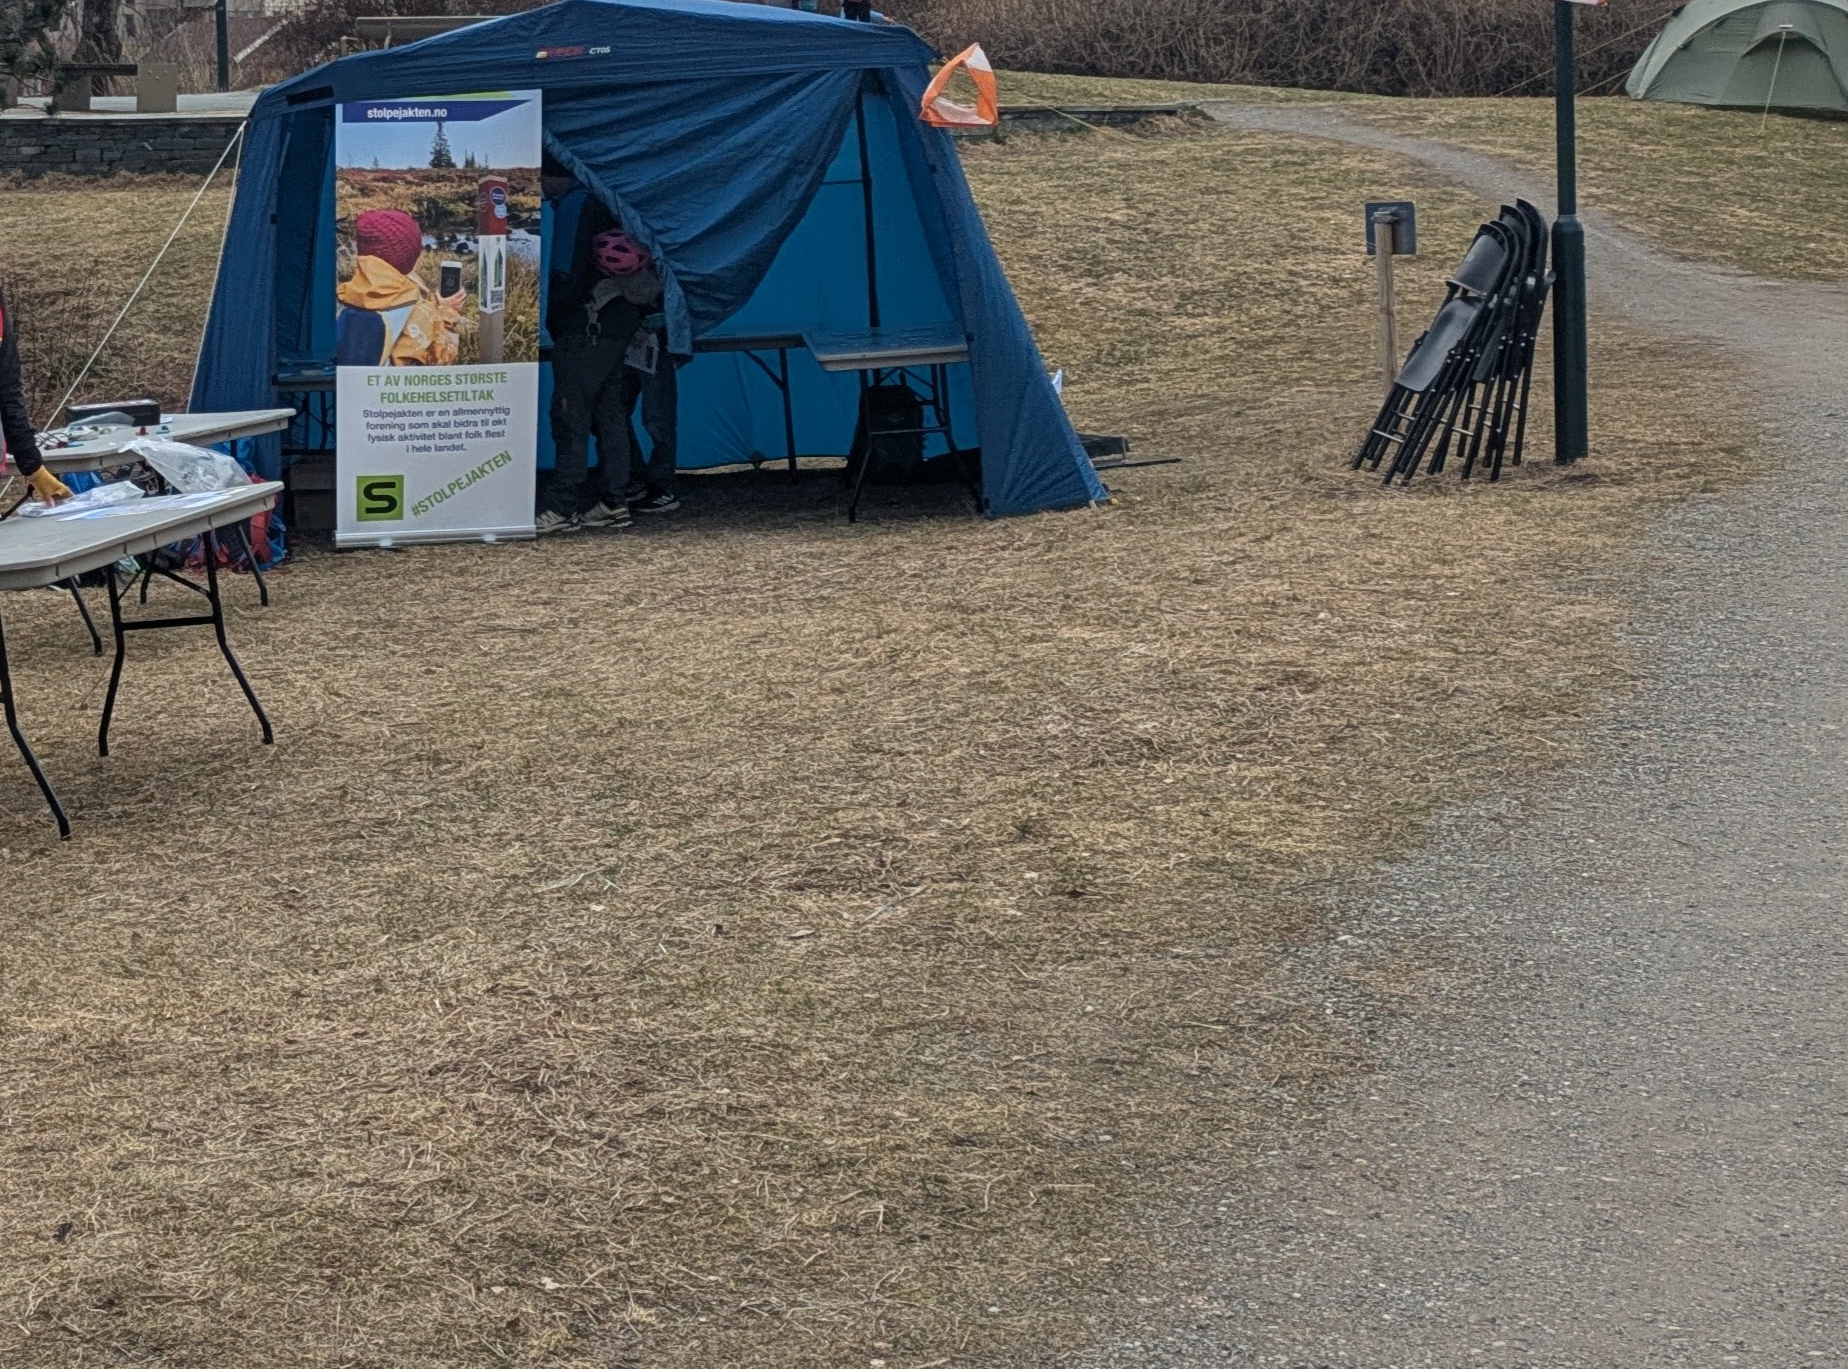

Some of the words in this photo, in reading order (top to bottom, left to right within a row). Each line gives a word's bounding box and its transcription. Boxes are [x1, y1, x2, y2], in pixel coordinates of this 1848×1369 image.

[367, 107, 448, 120] stolpejakten.no
[367, 375, 382, 386] ET
[384, 374, 400, 386] AV
[404, 374, 452, 386] NORGES
[455, 372, 508, 385] STØRSTE
[380, 389, 494, 404] FOLKEHELSETILTAK
[362, 409, 423, 420] Stolpejakten
[426, 410, 436, 418] er
[438, 409, 450, 417] en
[366, 421, 406, 432] forening
[408, 422, 429, 430] som
[432, 420, 451, 429] skal
[454, 419, 478, 428] bidra
[480, 418, 490, 427] til
[367, 433, 395, 444] fysisk
[398, 432, 436, 442] aktivitet
[438, 431, 463, 441] blant
[465, 430, 483, 440] folk
[412, 444, 432, 453] hele
[411, 450, 513, 517] #STOLPEJAKTEN
[363, 481, 398, 515] S
